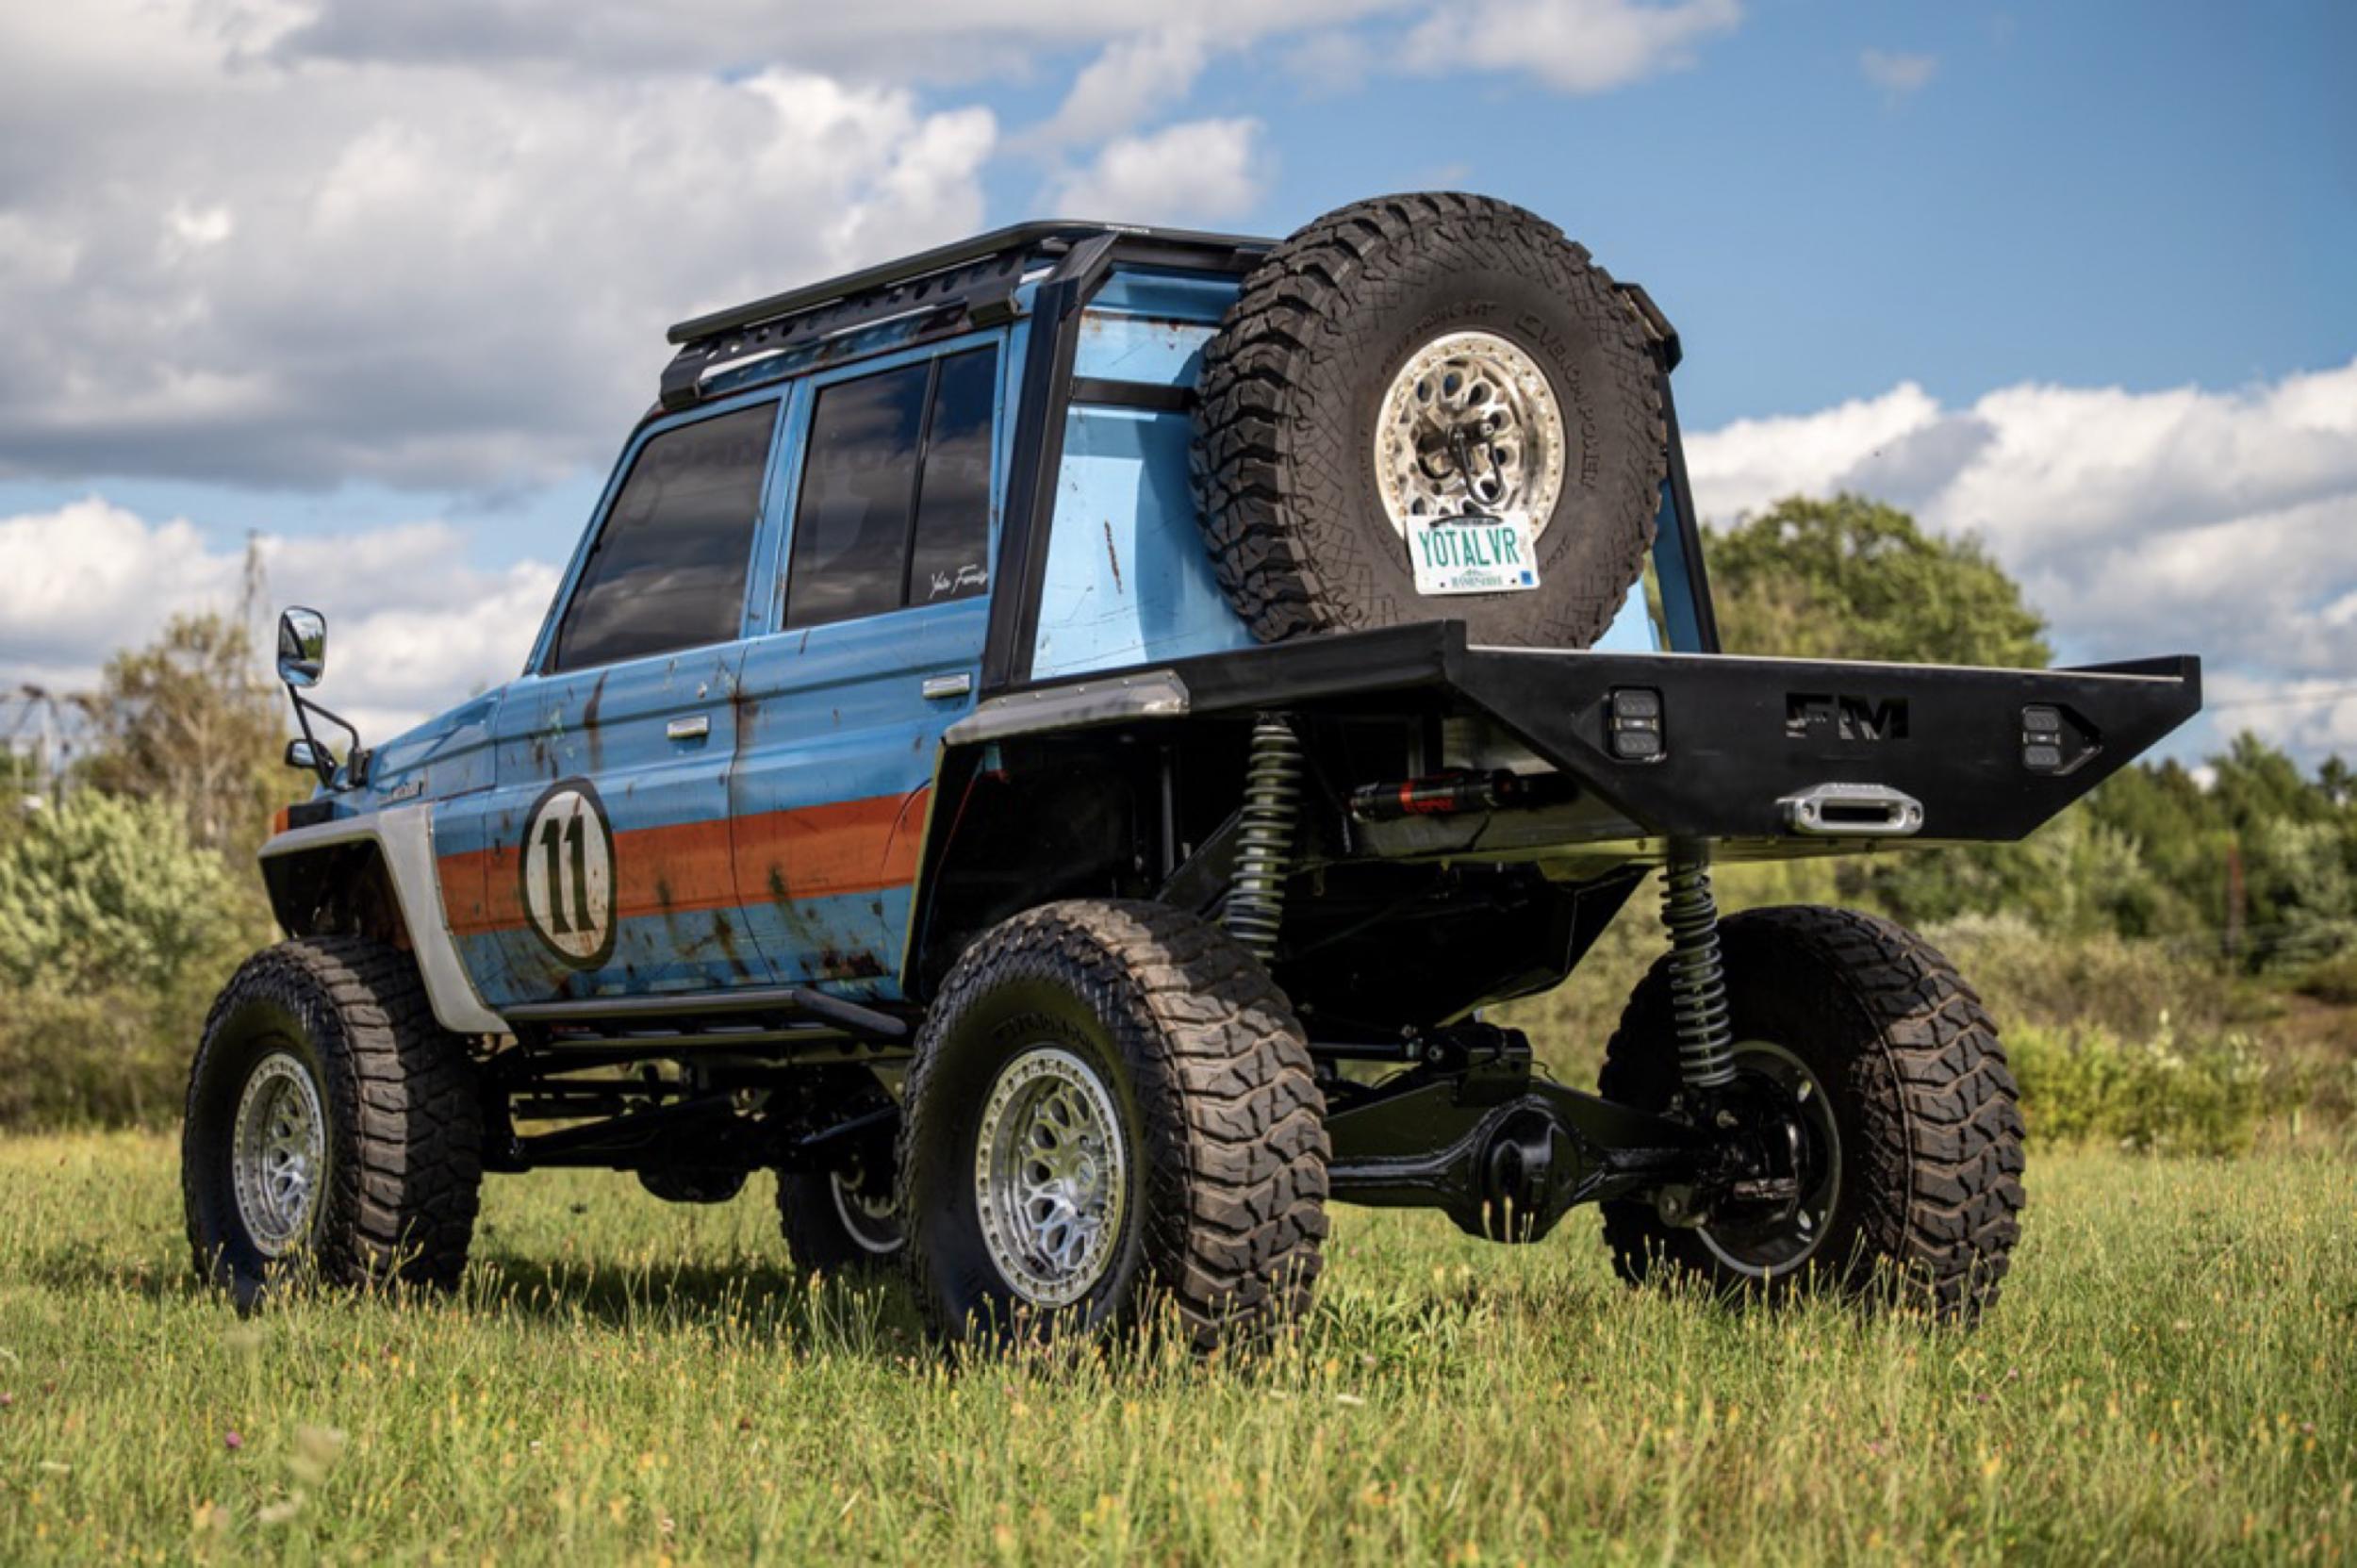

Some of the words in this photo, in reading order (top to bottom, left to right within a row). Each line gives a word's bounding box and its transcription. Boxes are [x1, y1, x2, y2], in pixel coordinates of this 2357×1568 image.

[1418, 527, 1521, 569] YOTALVR
[1786, 692, 1909, 740] FM
[540, 815, 597, 935] 11
